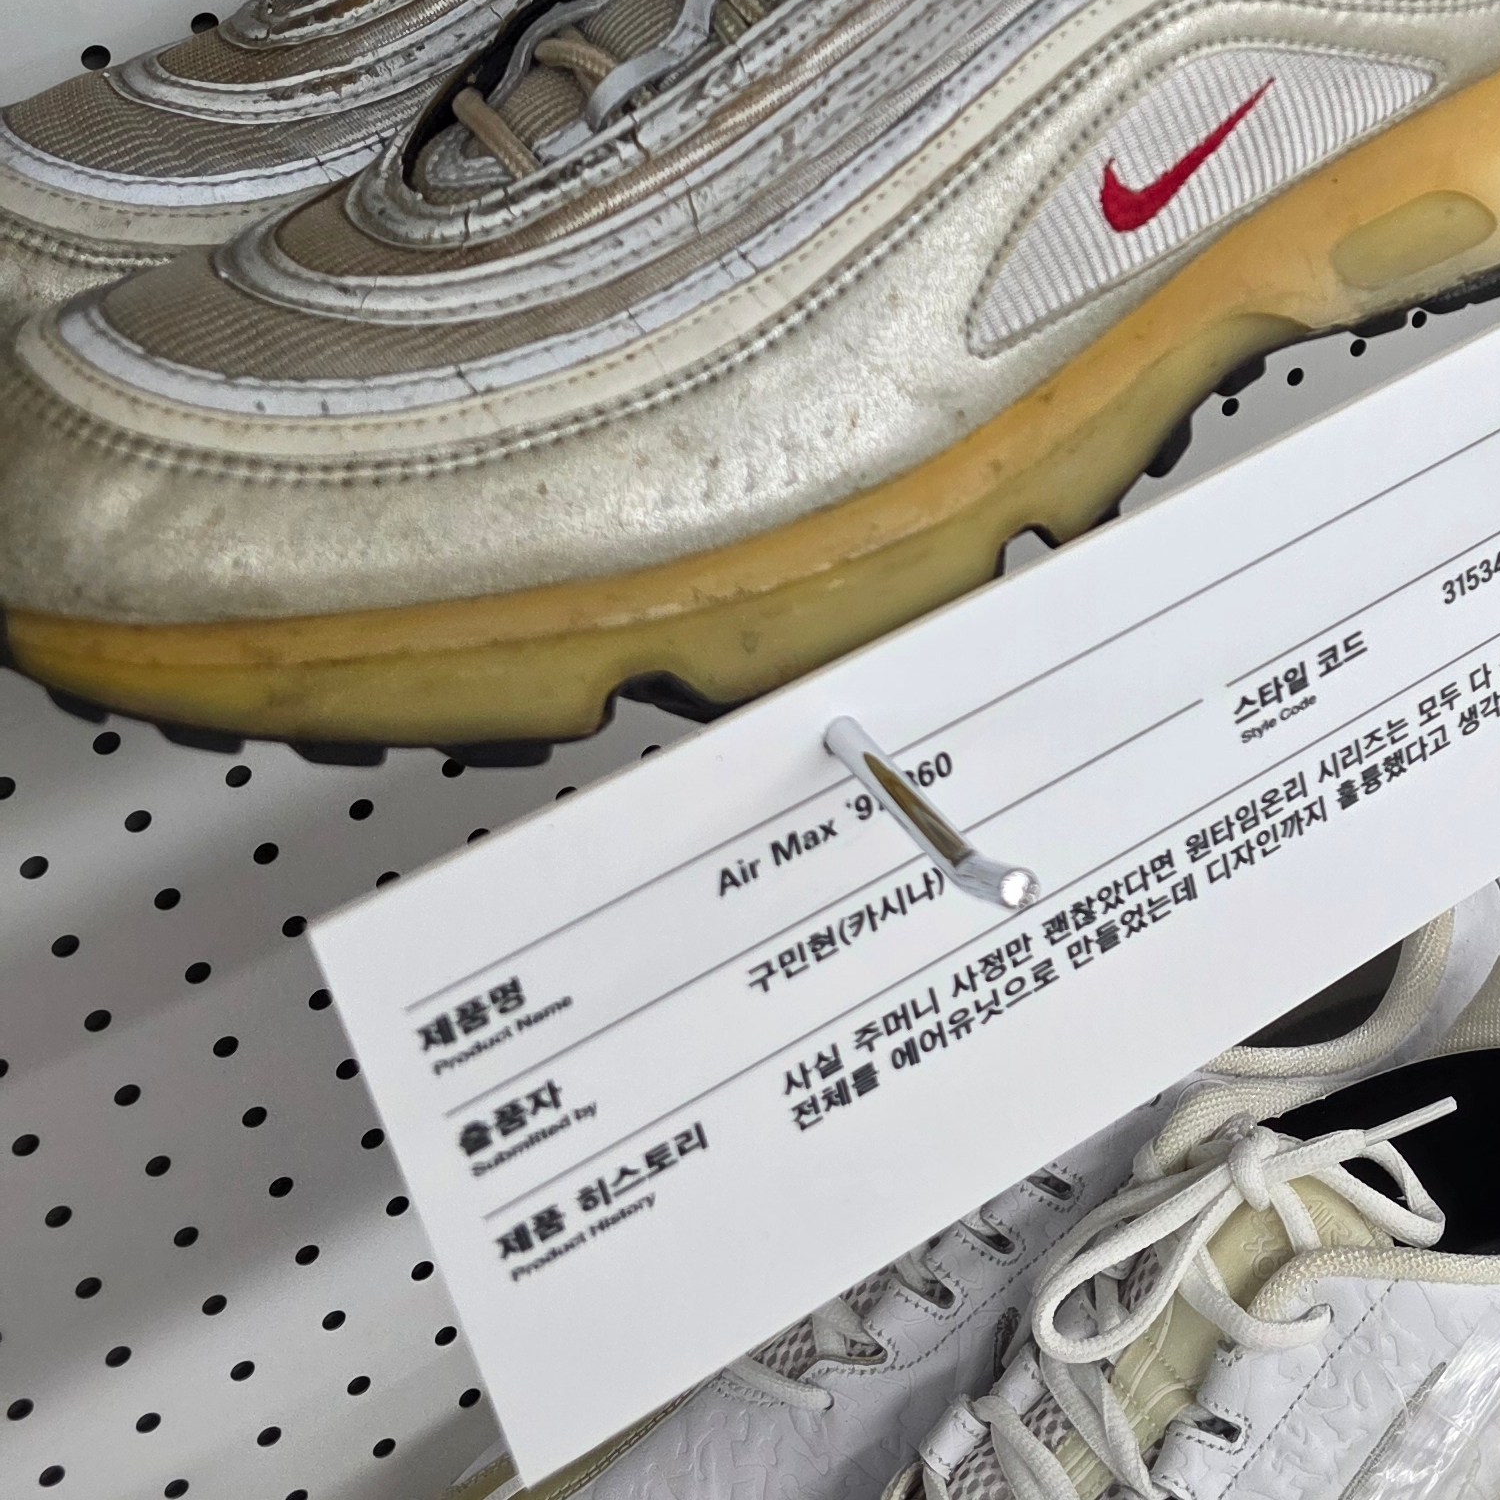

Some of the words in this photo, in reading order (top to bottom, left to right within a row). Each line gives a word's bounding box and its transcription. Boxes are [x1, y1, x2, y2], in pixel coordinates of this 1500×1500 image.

[1233, 661, 1309, 725] 스타일
[1317, 630, 1369, 679] 코드
[1240, 716, 1277, 744] Style
[1279, 694, 1318, 721] Code
[717, 858, 761, 900] Air
[770, 818, 840, 868] Max
[845, 793, 886, 823] '9
[782, 1043, 844, 1096] 사실
[853, 987, 941, 1054] 주머니
[951, 932, 1034, 999] 사정만
[1040, 849, 1177, 947] 괜찮았다면
[1185, 771, 1308, 863] 원타임온리
[1317, 717, 1409, 784] 시리즈는
[1418, 681, 1462, 728] 모두
[1469, 662, 1492, 693] 다
[747, 866, 945, 993] 구민현(카시나)
[791, 1061, 880, 1131] 전체를
[890, 959, 1060, 1071] 에어유닛으로
[1066, 874, 1198, 970] 만들었는데
[1207, 797, 1329, 886] 디자인까지
[1336, 725, 1451, 811] 훌륭했다고
[415, 975, 526, 1052] 제품명
[432, 1024, 513, 1077] Product
[515, 995, 574, 1035] Name
[458, 1078, 562, 1157] 출품자
[470, 1116, 572, 1178] Submitted
[573, 1100, 598, 1124] by
[495, 1203, 566, 1260] 제품
[576, 1120, 709, 1213] 히스토리
[510, 1231, 587, 1282] Product
[589, 1192, 657, 1238] History
